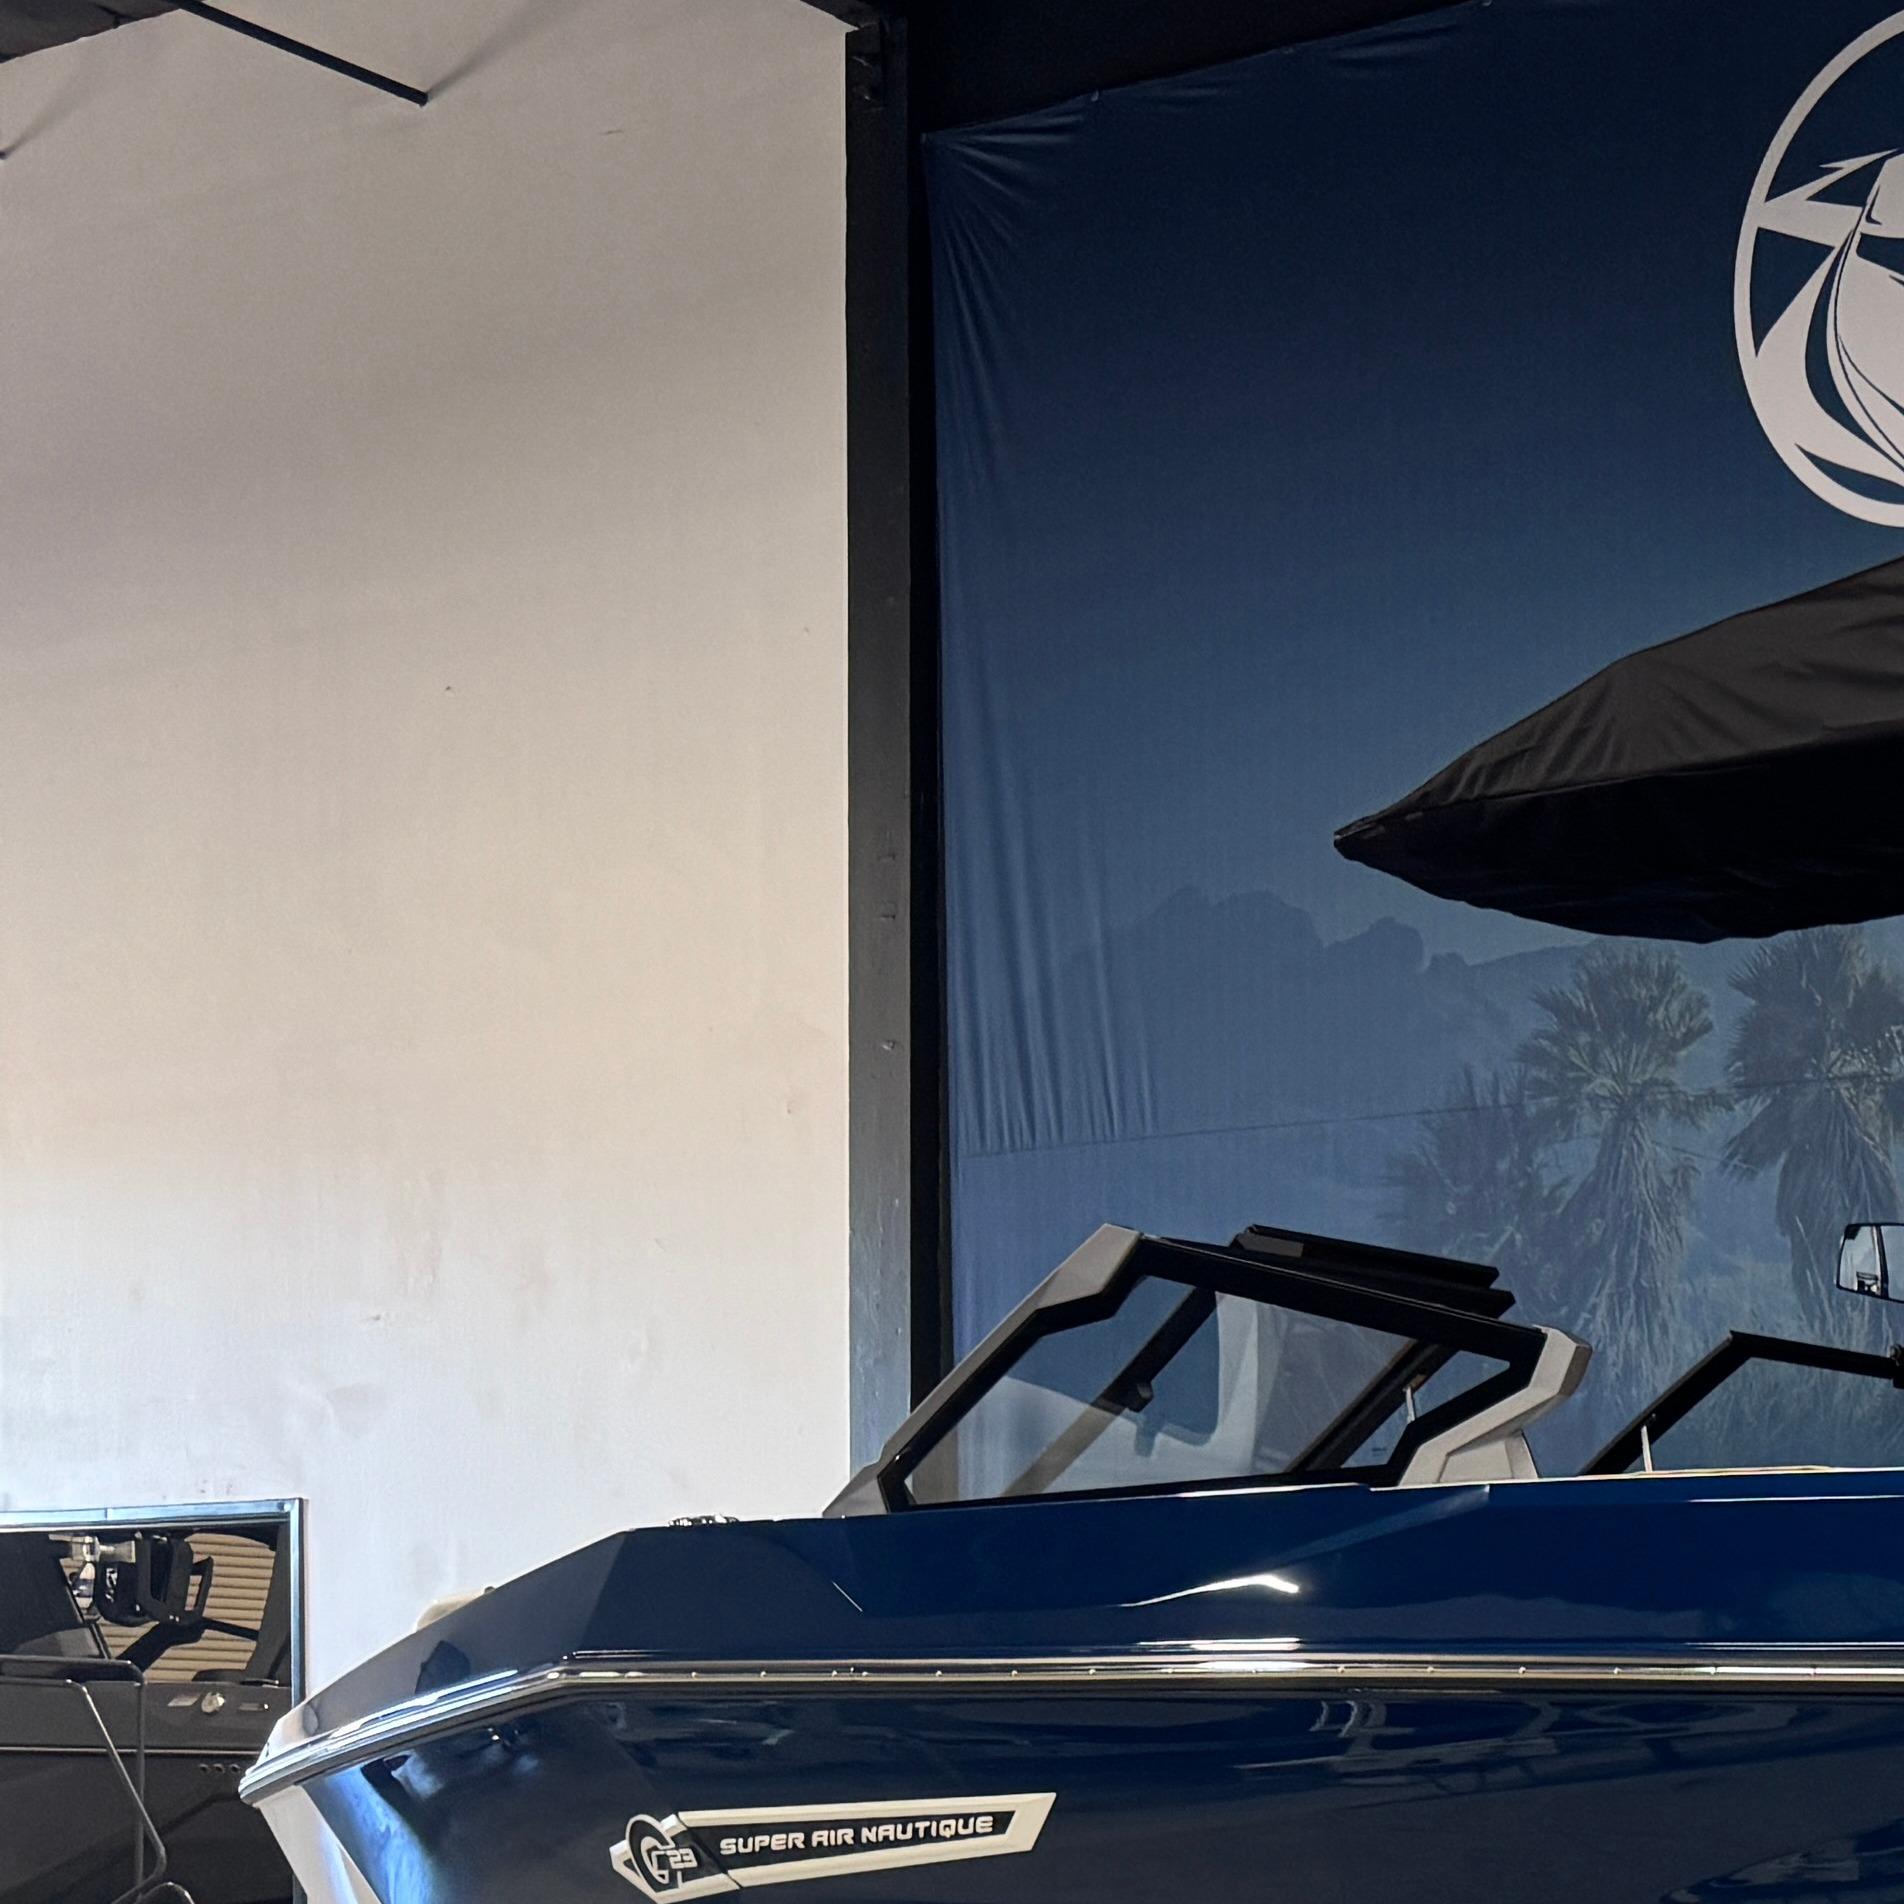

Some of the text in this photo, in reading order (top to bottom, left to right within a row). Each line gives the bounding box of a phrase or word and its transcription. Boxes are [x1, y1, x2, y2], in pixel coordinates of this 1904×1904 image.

[719, 1815, 994, 1856] SUPER AIR NAUTIQUE
